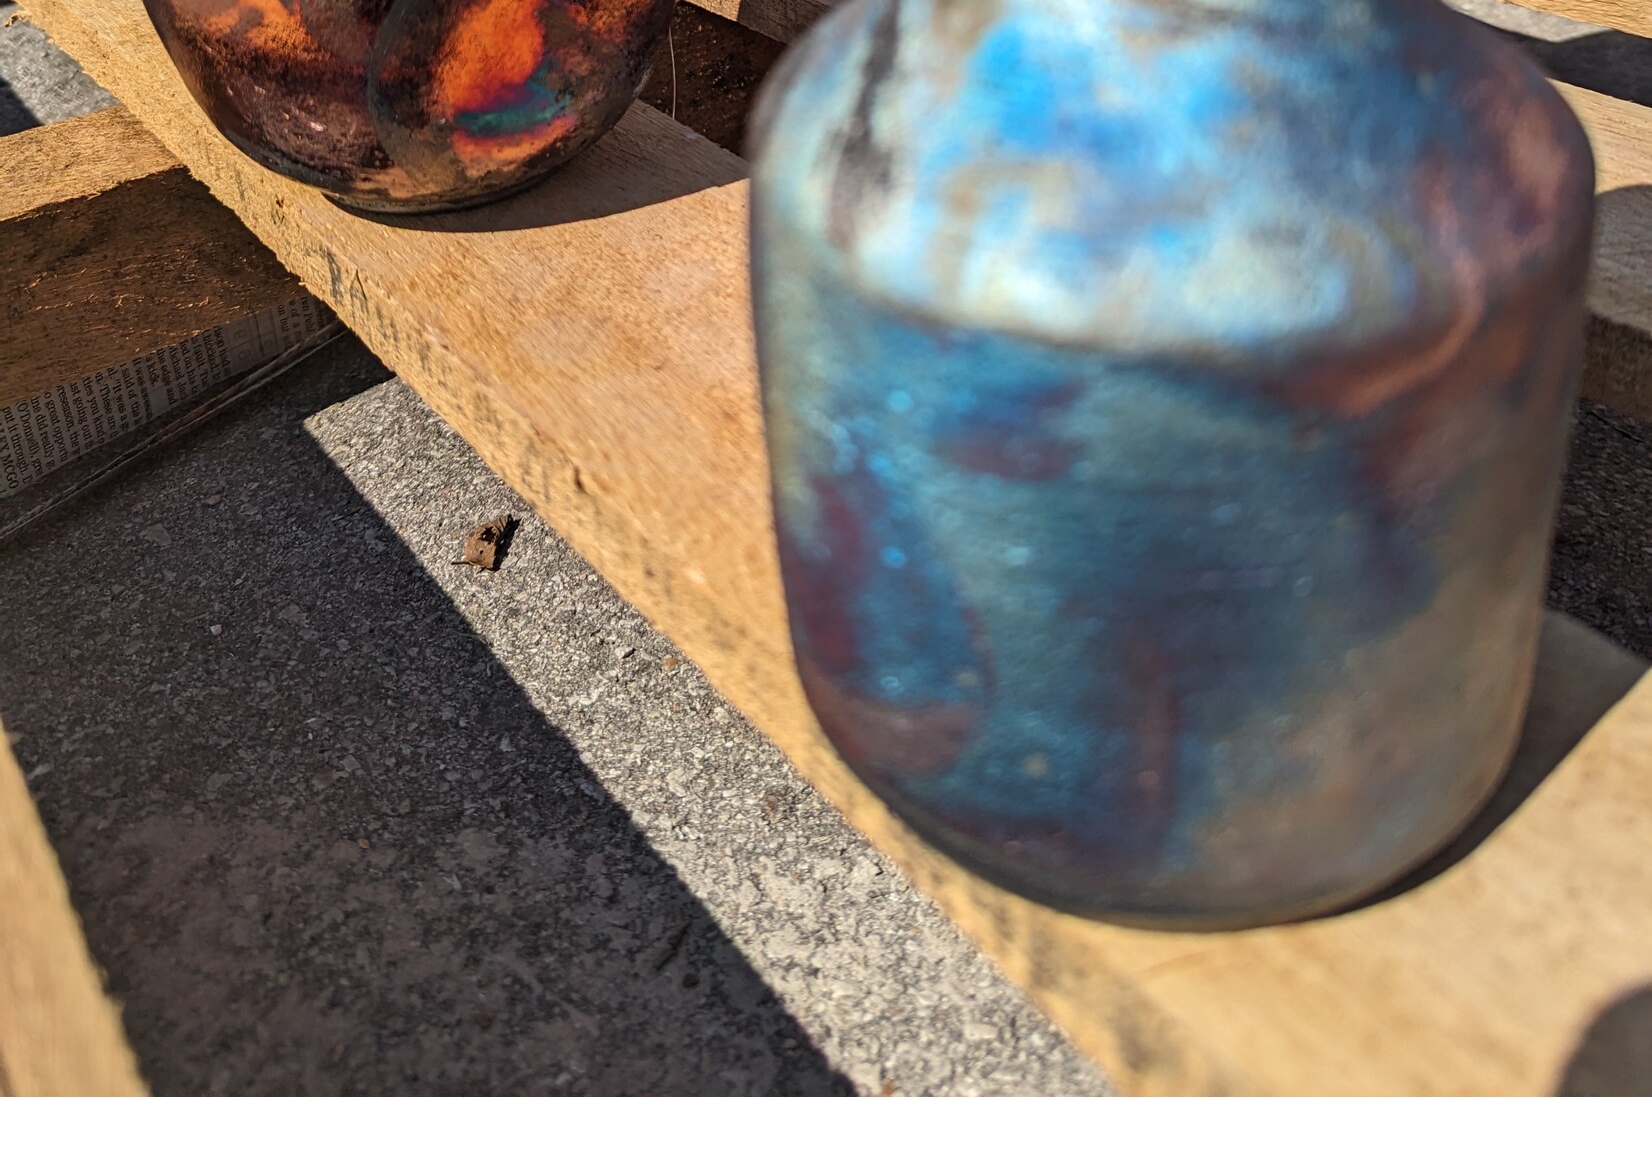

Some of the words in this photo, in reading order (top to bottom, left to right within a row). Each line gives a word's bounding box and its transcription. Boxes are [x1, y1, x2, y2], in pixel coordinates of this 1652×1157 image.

[183, 356, 192, 369] on
[121, 367, 135, 389] said
[134, 366, 145, 386] was
[156, 347, 166, 364] the
[166, 387, 178, 405] and
[186, 367, 197, 385] his
[115, 394, 126, 413] was
[127, 388, 138, 399] of
[44, 399, 60, 426] great
[86, 396, 99, 415] you
[93, 414, 106, 438] kind
[99, 383, 112, 414] These
[106, 414, 116, 430] are
[35, 413, 48, 431] did
[72, 396, 87, 424] going
[81, 424, 92, 440] out
[1, 406, 15, 425] put
[10, 432, 29, 475] through.
[39, 430, 54, 458] really
[69, 430, 80, 447] the
